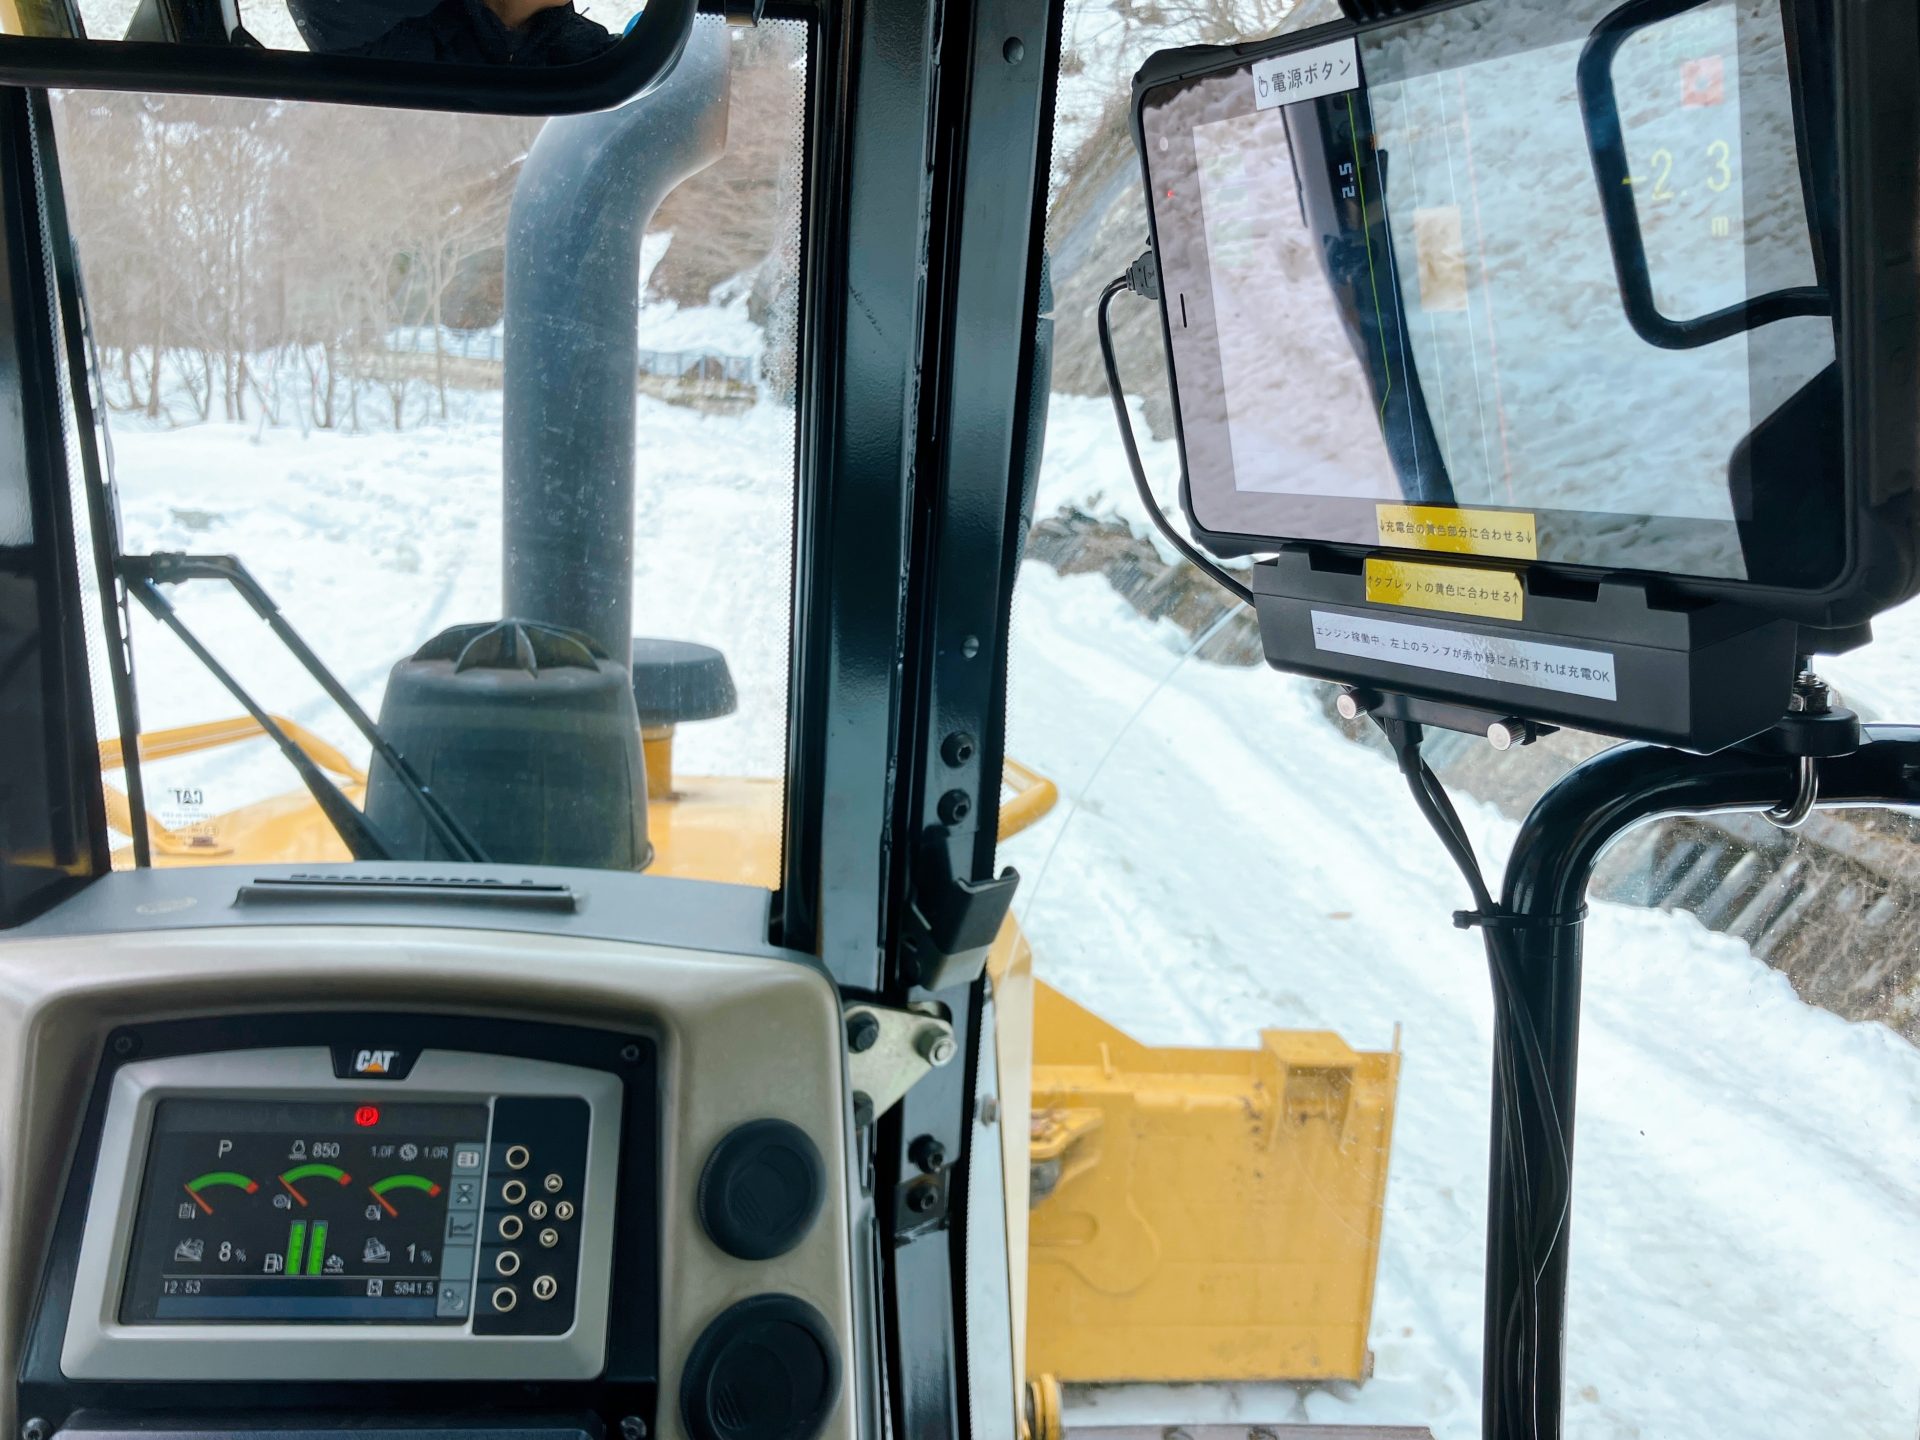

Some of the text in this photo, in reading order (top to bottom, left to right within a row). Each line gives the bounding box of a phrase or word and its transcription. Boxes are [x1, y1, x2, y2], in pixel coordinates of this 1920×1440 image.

[1271, 58, 1351, 93] 電源ボタン
[1385, 520, 1525, 543] 充電台の黄色部分に合わせる
[1375, 576, 1512, 603] タブレットの黄色に合わせる
[355, 1049, 395, 1073] CAT
[218, 1139, 233, 1159] P
[312, 1142, 341, 1159] 850
